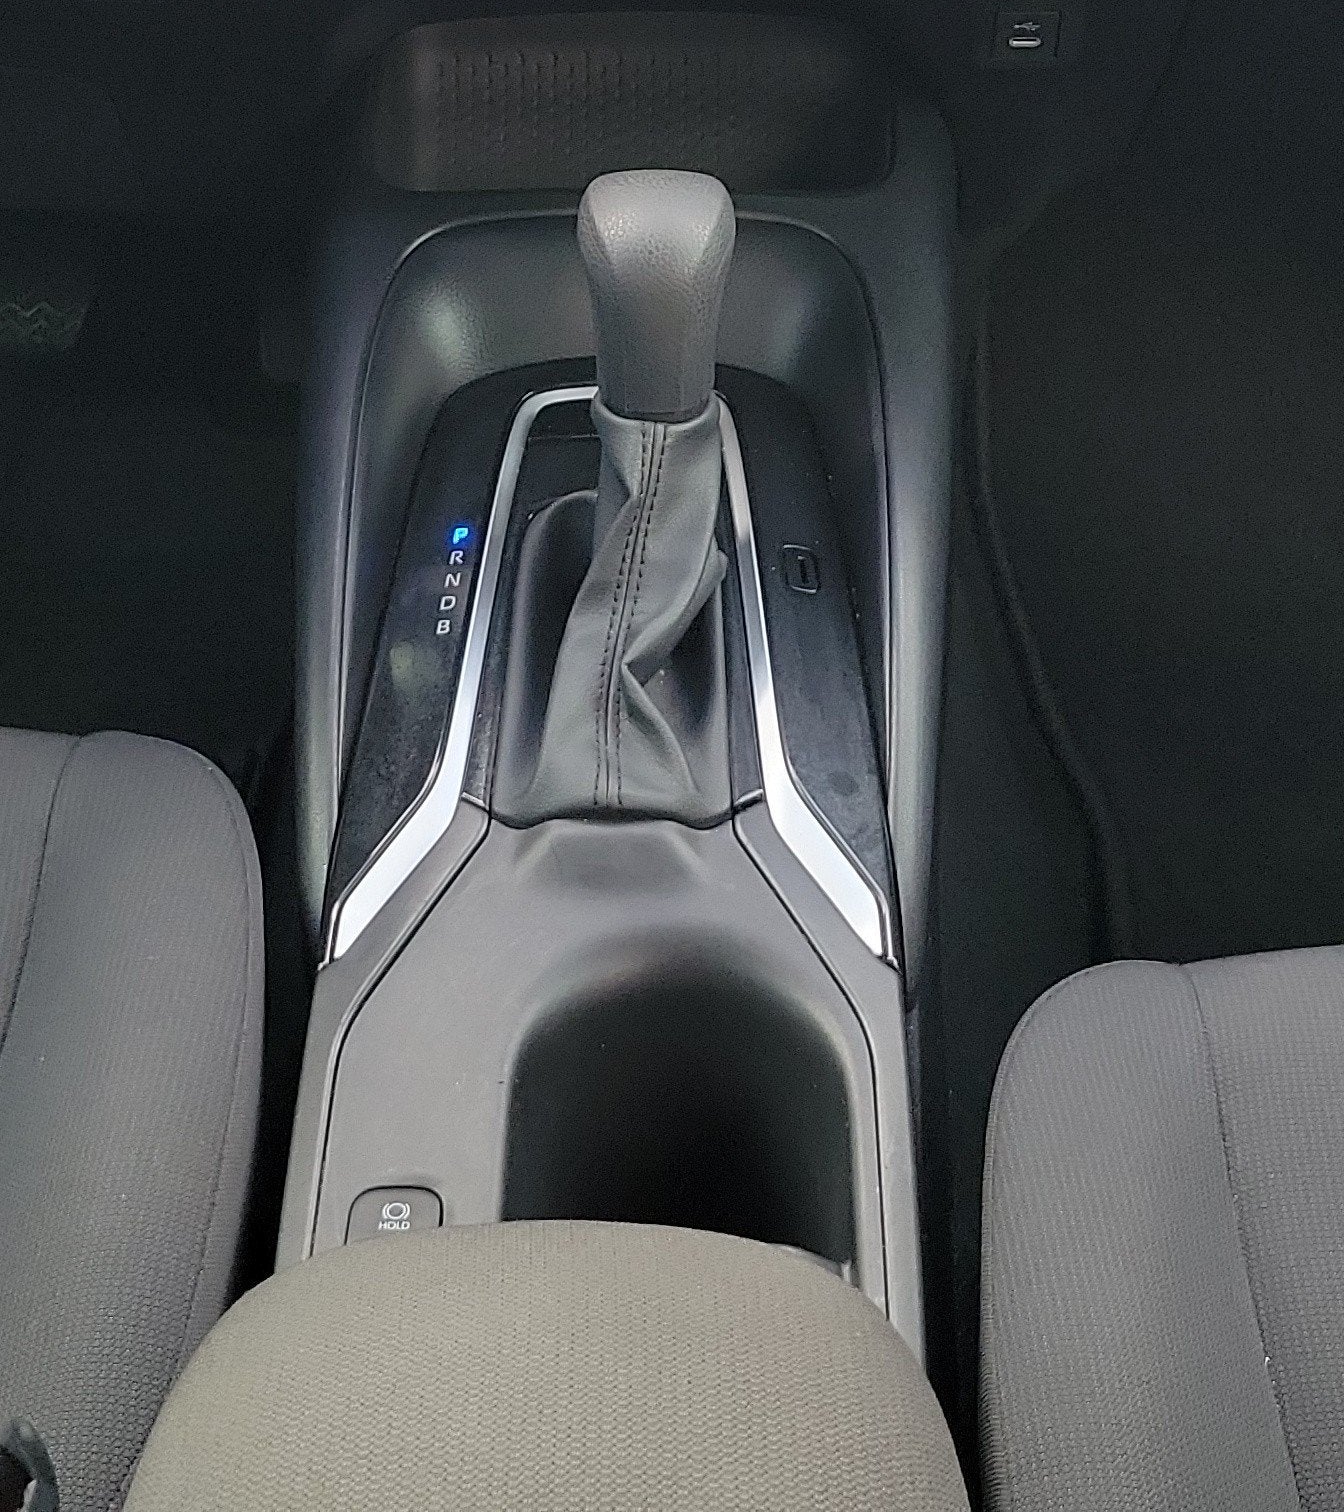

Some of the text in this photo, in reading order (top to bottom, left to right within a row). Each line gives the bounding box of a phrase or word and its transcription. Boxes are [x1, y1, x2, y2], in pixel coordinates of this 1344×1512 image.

[453, 527, 469, 544] P
[449, 550, 464, 565] R
[444, 572, 461, 588] N
[439, 595, 456, 611] D
[435, 619, 451, 635] B
[378, 1221, 411, 1230] HOLD
